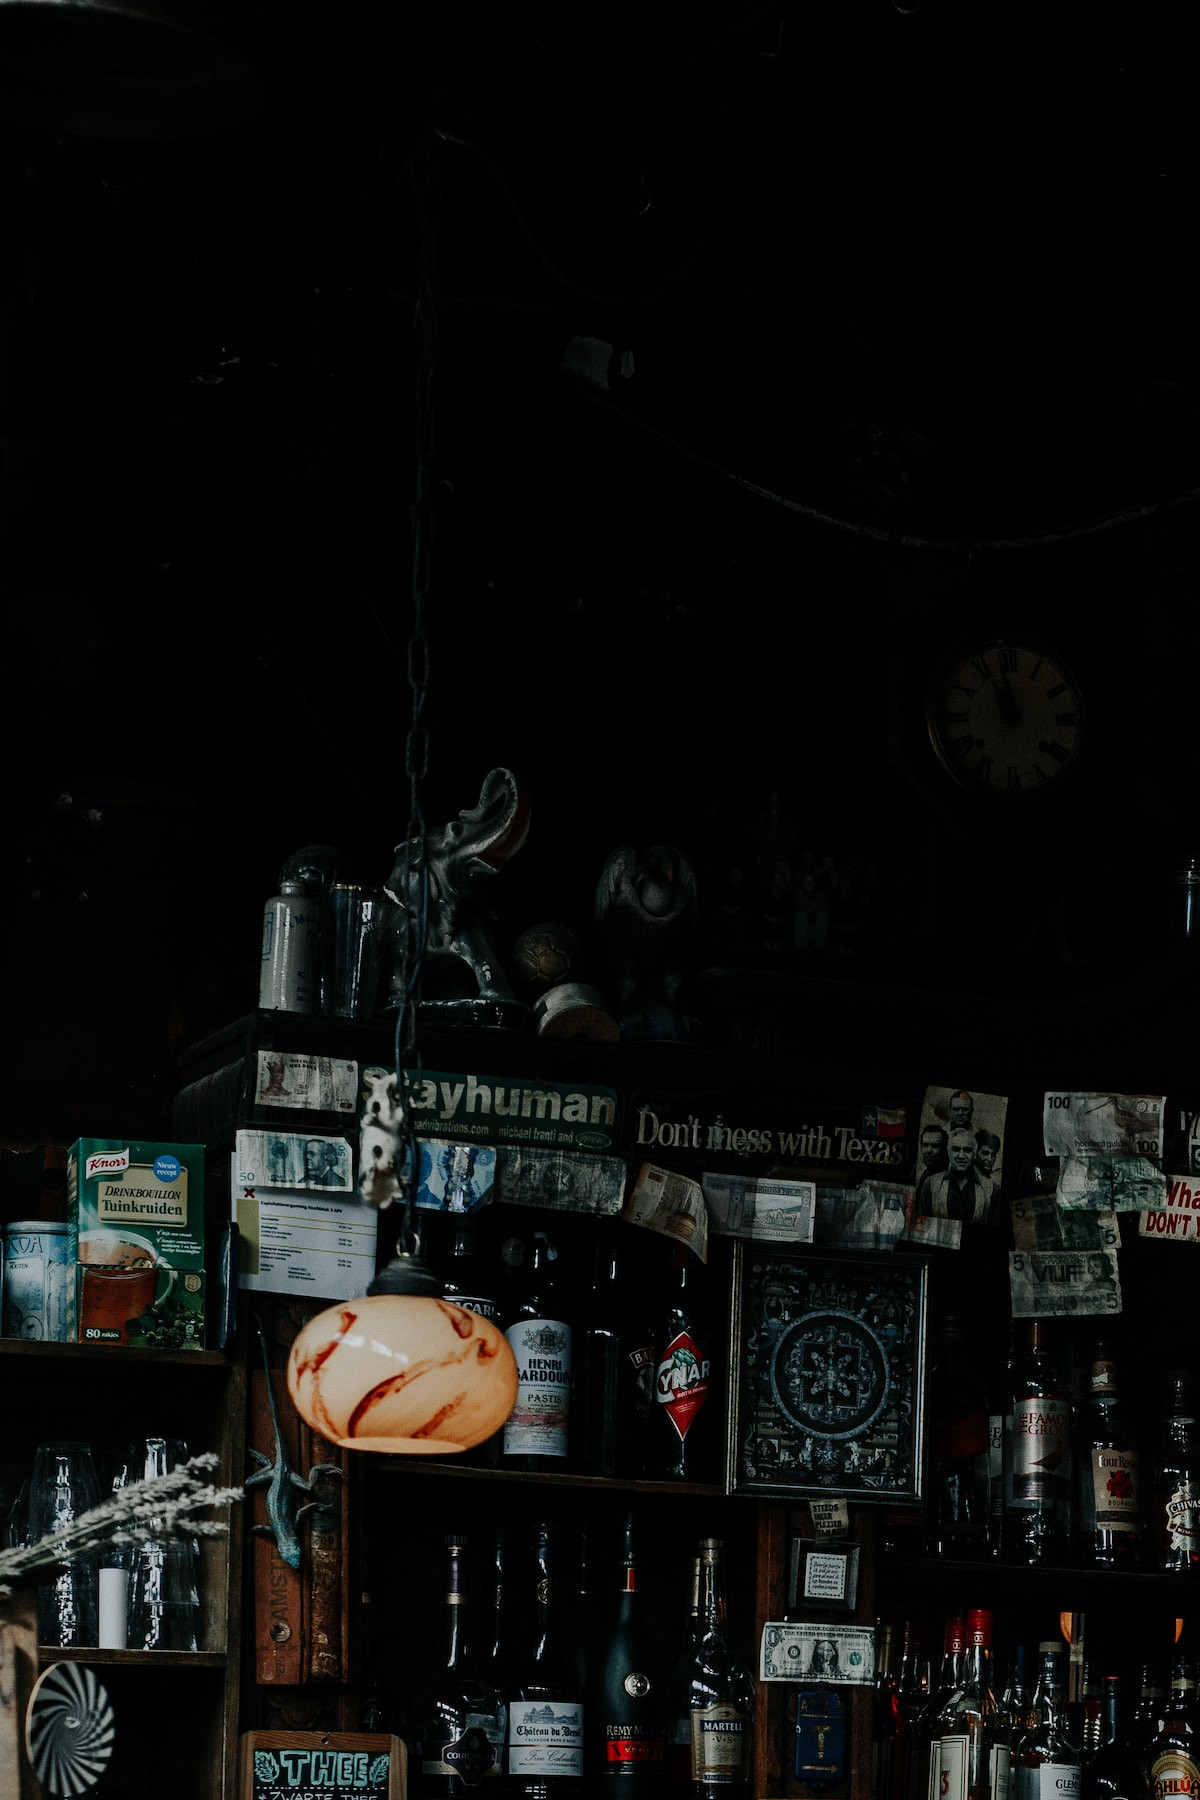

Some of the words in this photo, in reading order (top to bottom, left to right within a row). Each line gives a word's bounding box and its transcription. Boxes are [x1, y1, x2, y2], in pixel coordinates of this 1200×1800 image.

[1047, 1097, 1070, 1109] 100
[499, 1125, 531, 1139] michael
[533, 1128, 557, 1140] franti
[558, 1132, 574, 1143] and
[1191, 1114, 1200, 1140] I
[636, 1111, 701, 1148] Don't
[706, 1122, 772, 1153] mess
[777, 1124, 832, 1159] with
[835, 1127, 903, 1165] Texas
[1136, 1141, 1158, 1153] 100
[90, 1156, 127, 1170] Knorr
[156, 1168, 177, 1177] recept
[239, 1173, 255, 1181] 50
[105, 1186, 182, 1200] DRINKBOUILLON
[102, 1200, 183, 1216] Tuinkruiden
[1015, 1204, 1025, 1219] 5
[1146, 1212, 1192, 1236] DON'T
[1106, 1229, 1116, 1245] 5
[1013, 1255, 1024, 1271] 5
[85, 1328, 101, 1339] 80
[528, 1358, 562, 1371] HENRI
[657, 1358, 711, 1403] CYNAR
[527, 1393, 562, 1404] PASTIS
[551, 1726, 560, 1735] du
[704, 1722, 743, 1731] MARTELL
[279, 1750, 369, 1787] THEE
